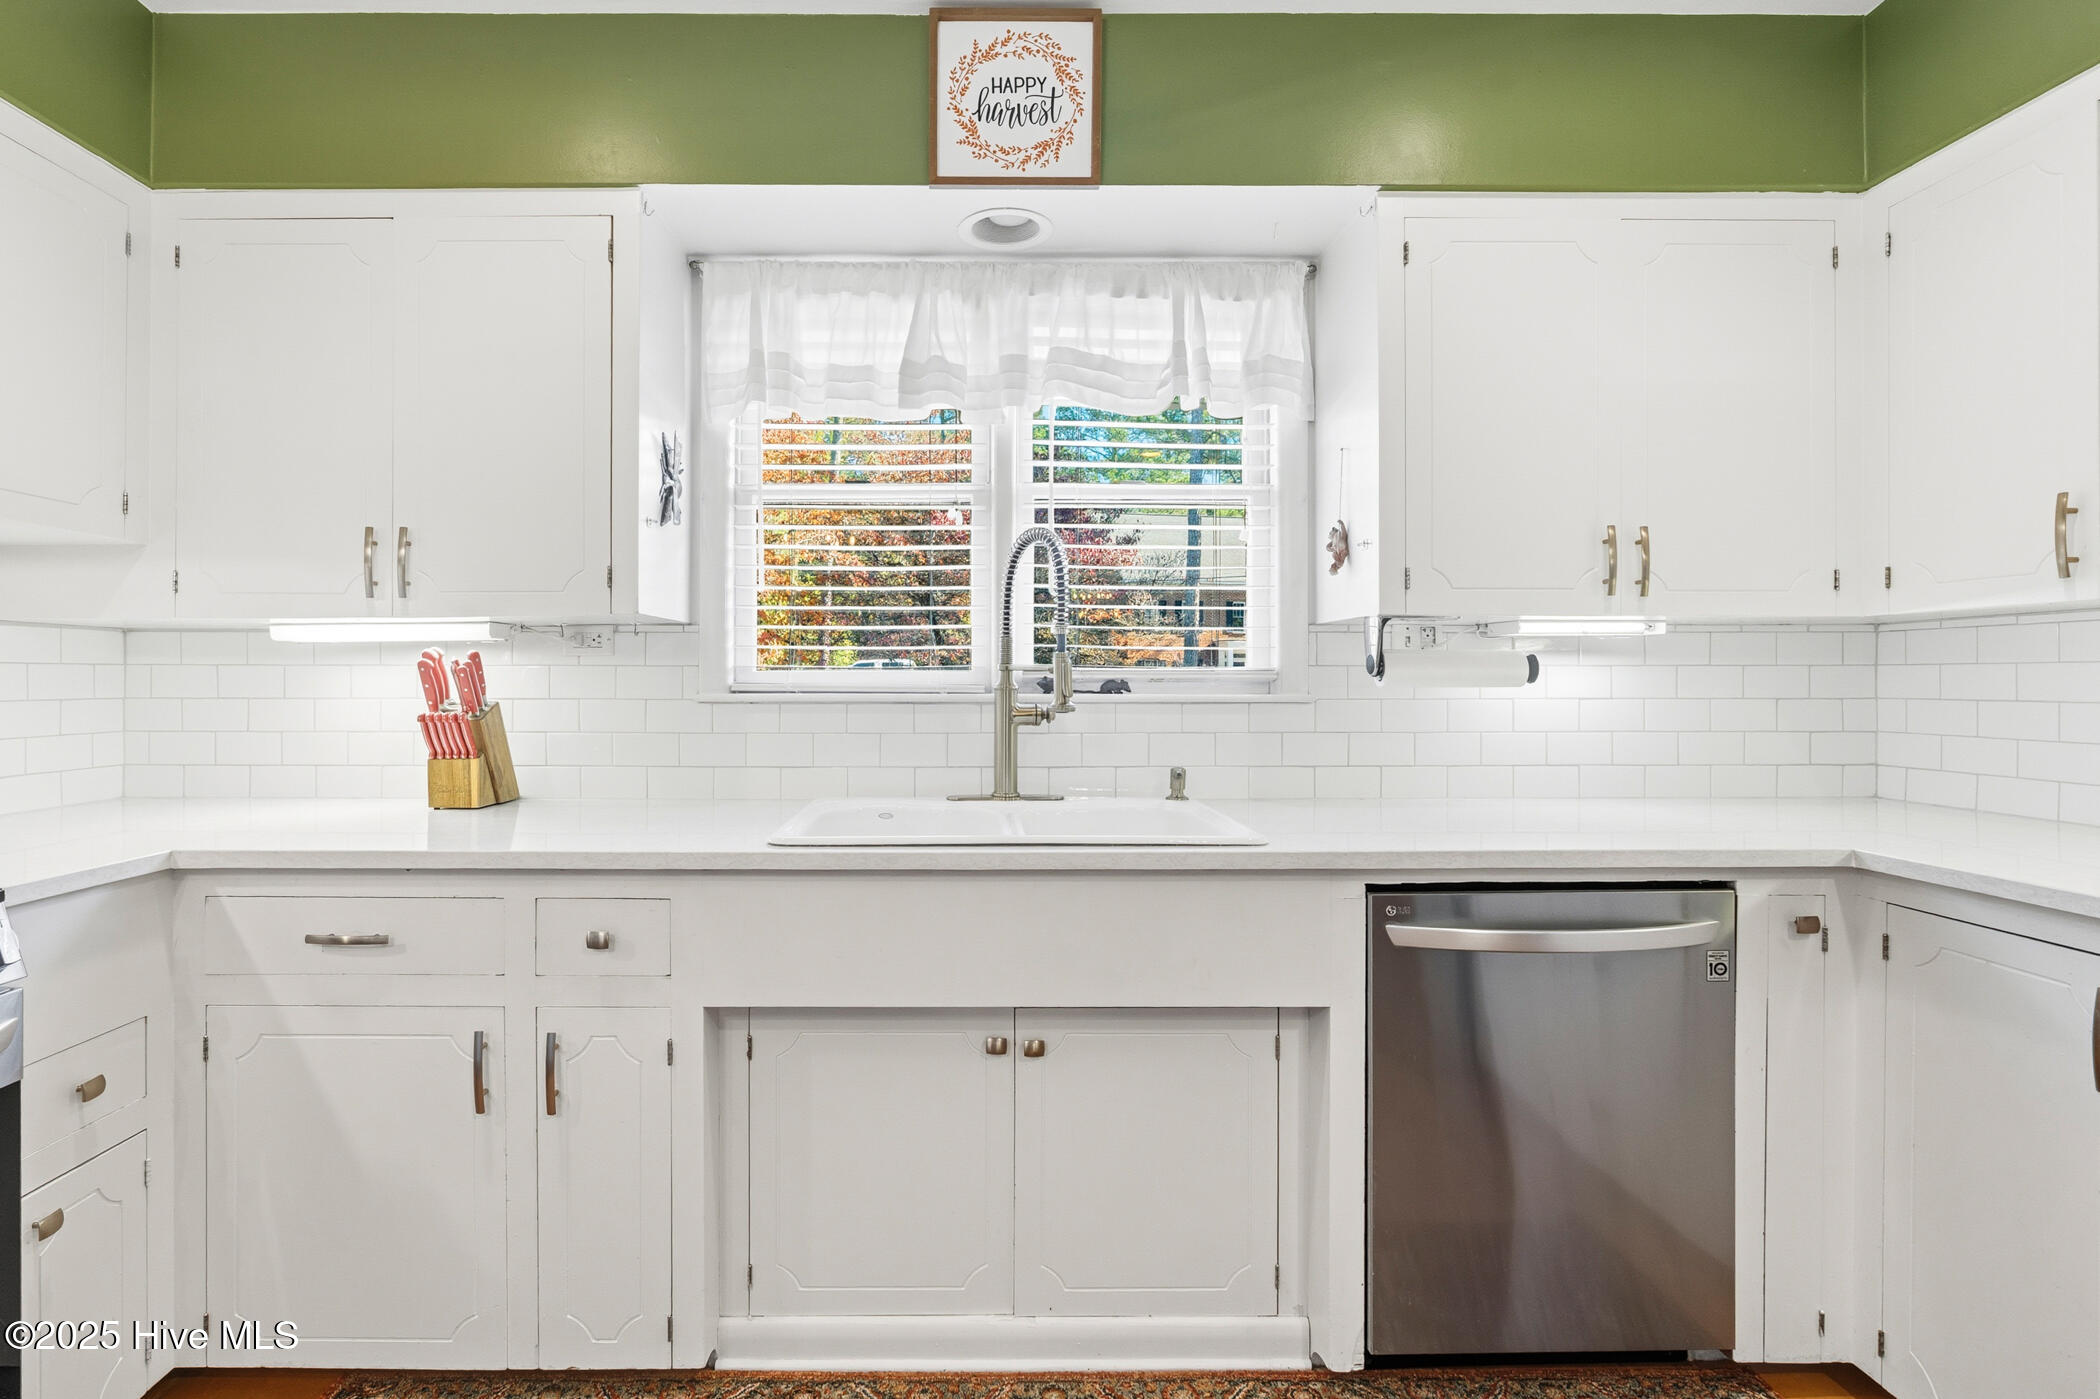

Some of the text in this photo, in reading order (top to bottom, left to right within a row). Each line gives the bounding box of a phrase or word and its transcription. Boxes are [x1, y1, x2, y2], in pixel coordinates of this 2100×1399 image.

[991, 76, 1047, 94] HAPPY
[972, 86, 1065, 129] harvest
[1709, 962, 1728, 977] 10
